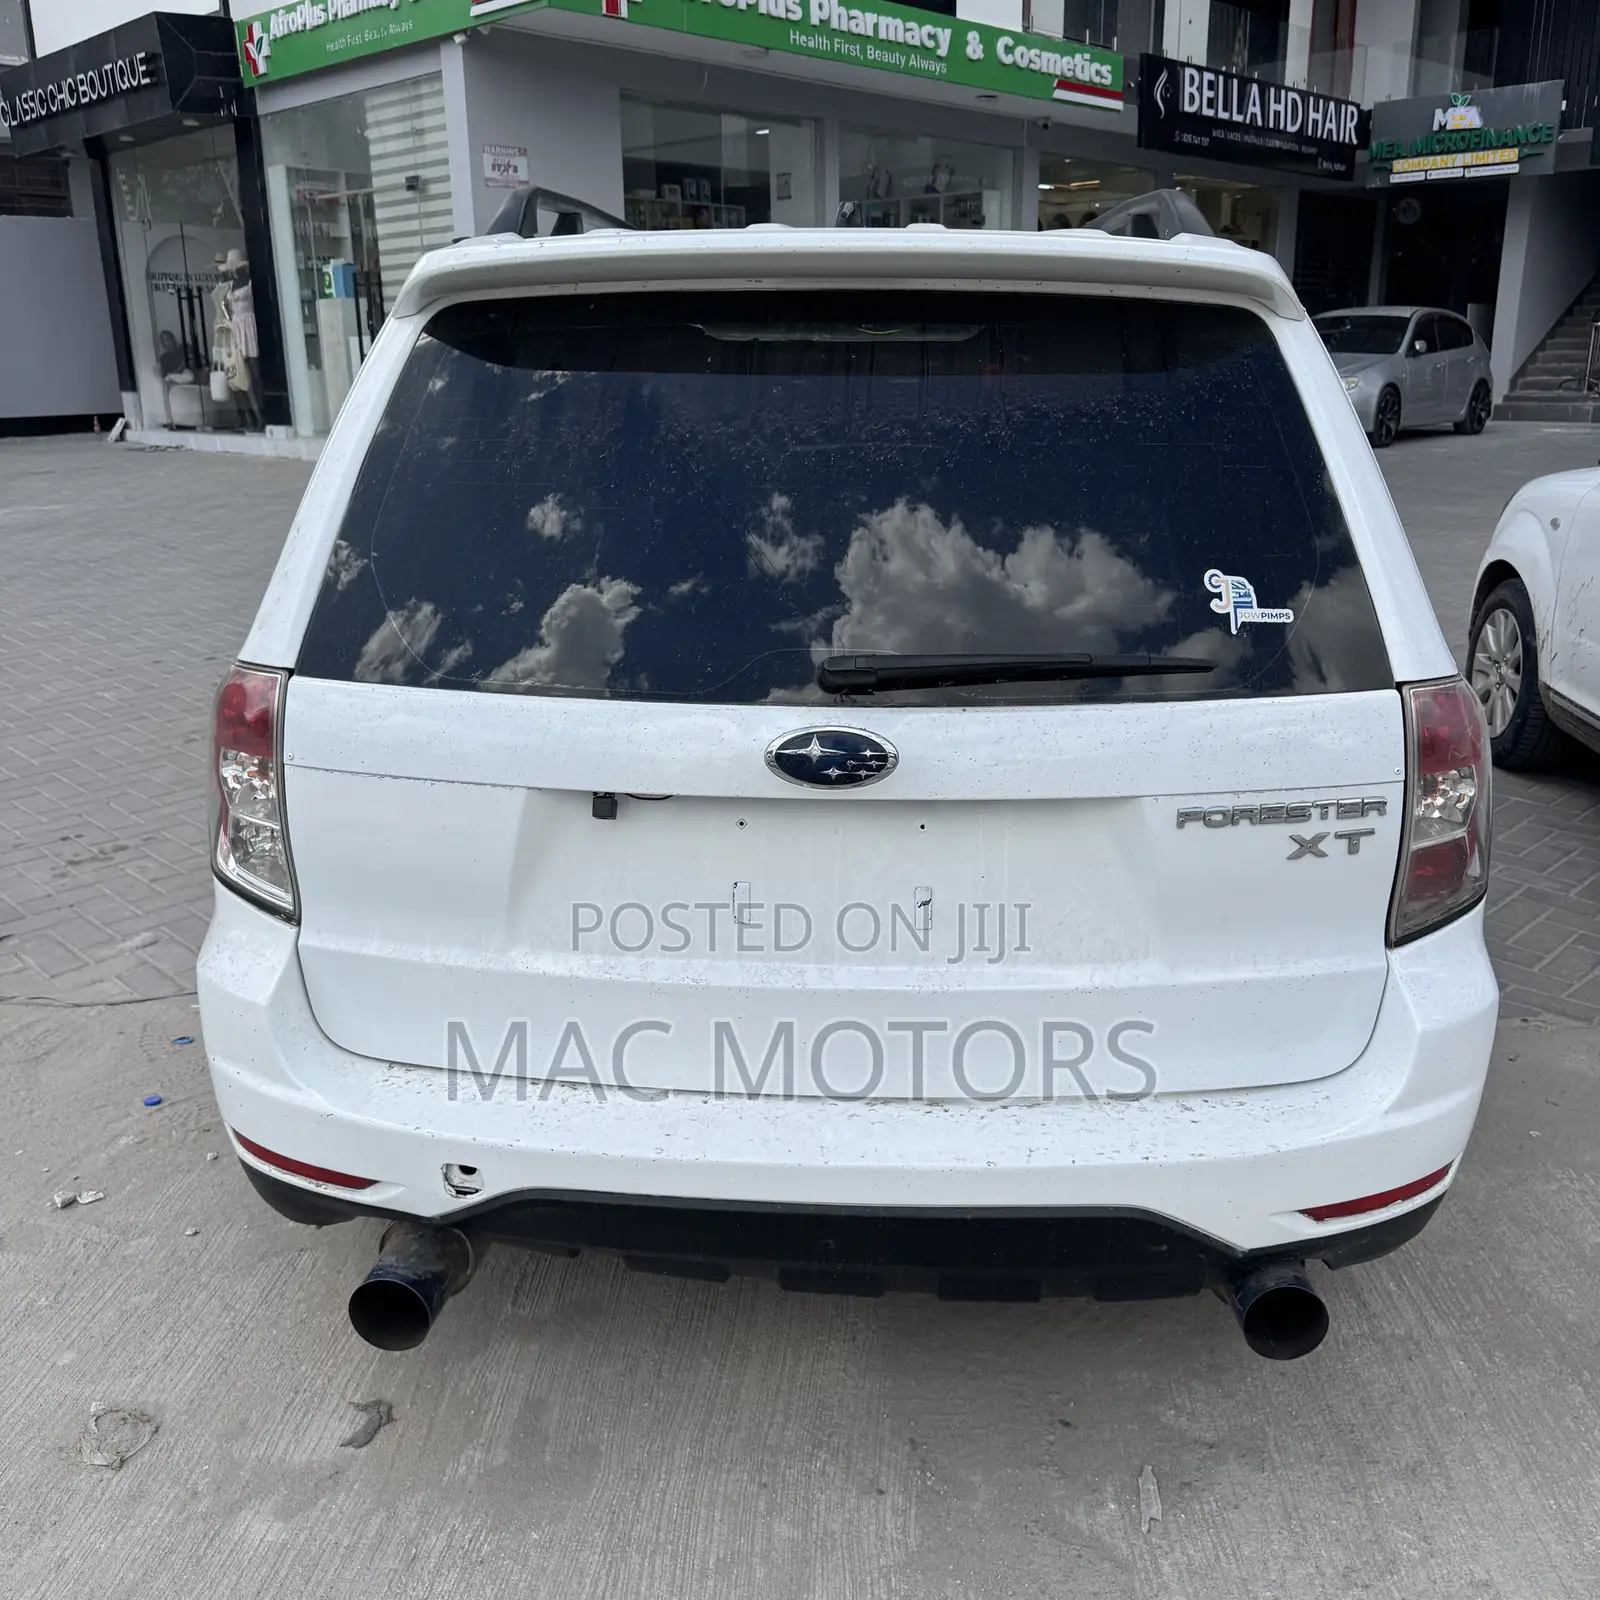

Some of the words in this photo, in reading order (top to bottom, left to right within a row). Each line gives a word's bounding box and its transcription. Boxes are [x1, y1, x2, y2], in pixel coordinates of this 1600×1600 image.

[270, 0, 328, 40] AfroPlus
[789, 29, 830, 51] Health
[834, 38, 864, 60] First,
[867, 45, 906, 69] Beauty
[908, 53, 947, 75] Always
[810, 0, 952, 57] Pharmacy
[966, 30, 984, 60] &
[996, 36, 1112, 86] Cosmetics
[0, 88, 47, 128] CLASSIC
[47, 77, 77, 112] CHIC
[77, 51, 151, 104] BOUTIQUE
[1182, 67, 1262, 127] BELLA
[1268, 87, 1301, 133] HD
[1307, 96, 1359, 146] HAIR
[1411, 122, 1555, 153] MICROFINANCE
[1393, 153, 1458, 173] COMPANY
[1463, 148, 1518, 167] LIMITED
[1239, 611, 1291, 620] JOWPIMPS
[1176, 796, 1387, 829] FORESTER
[1286, 828, 1376, 860] XT
